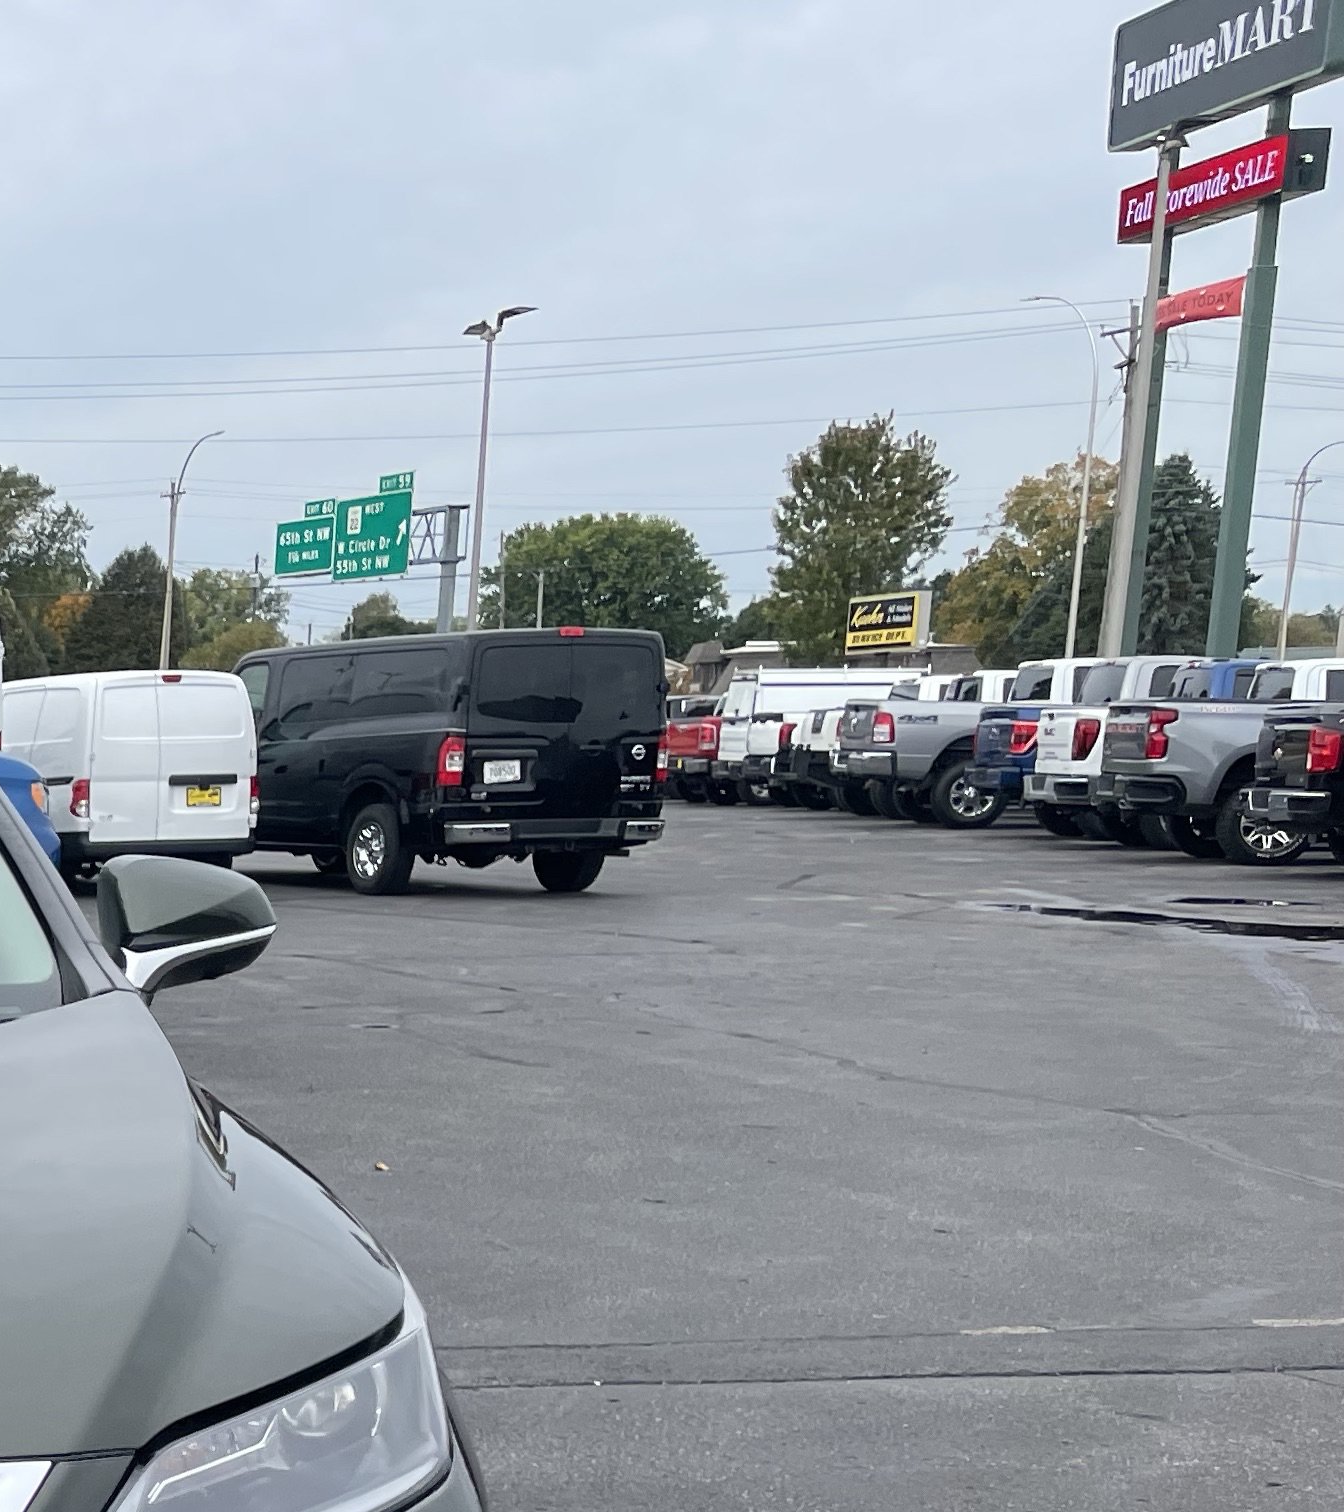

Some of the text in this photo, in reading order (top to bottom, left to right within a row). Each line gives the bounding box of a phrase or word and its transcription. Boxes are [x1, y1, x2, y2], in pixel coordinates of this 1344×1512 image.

[1121, 0, 1314, 107] FurnitureMART
[1125, 191, 1154, 227] Fall
[1231, 151, 1278, 192] SALE
[1193, 291, 1234, 309] TODAY
[399, 474, 412, 489] 59
[322, 501, 334, 514] 60
[304, 529, 314, 543] St
[379, 535, 391, 550] Dr
[335, 554, 390, 575] 55th St NW
